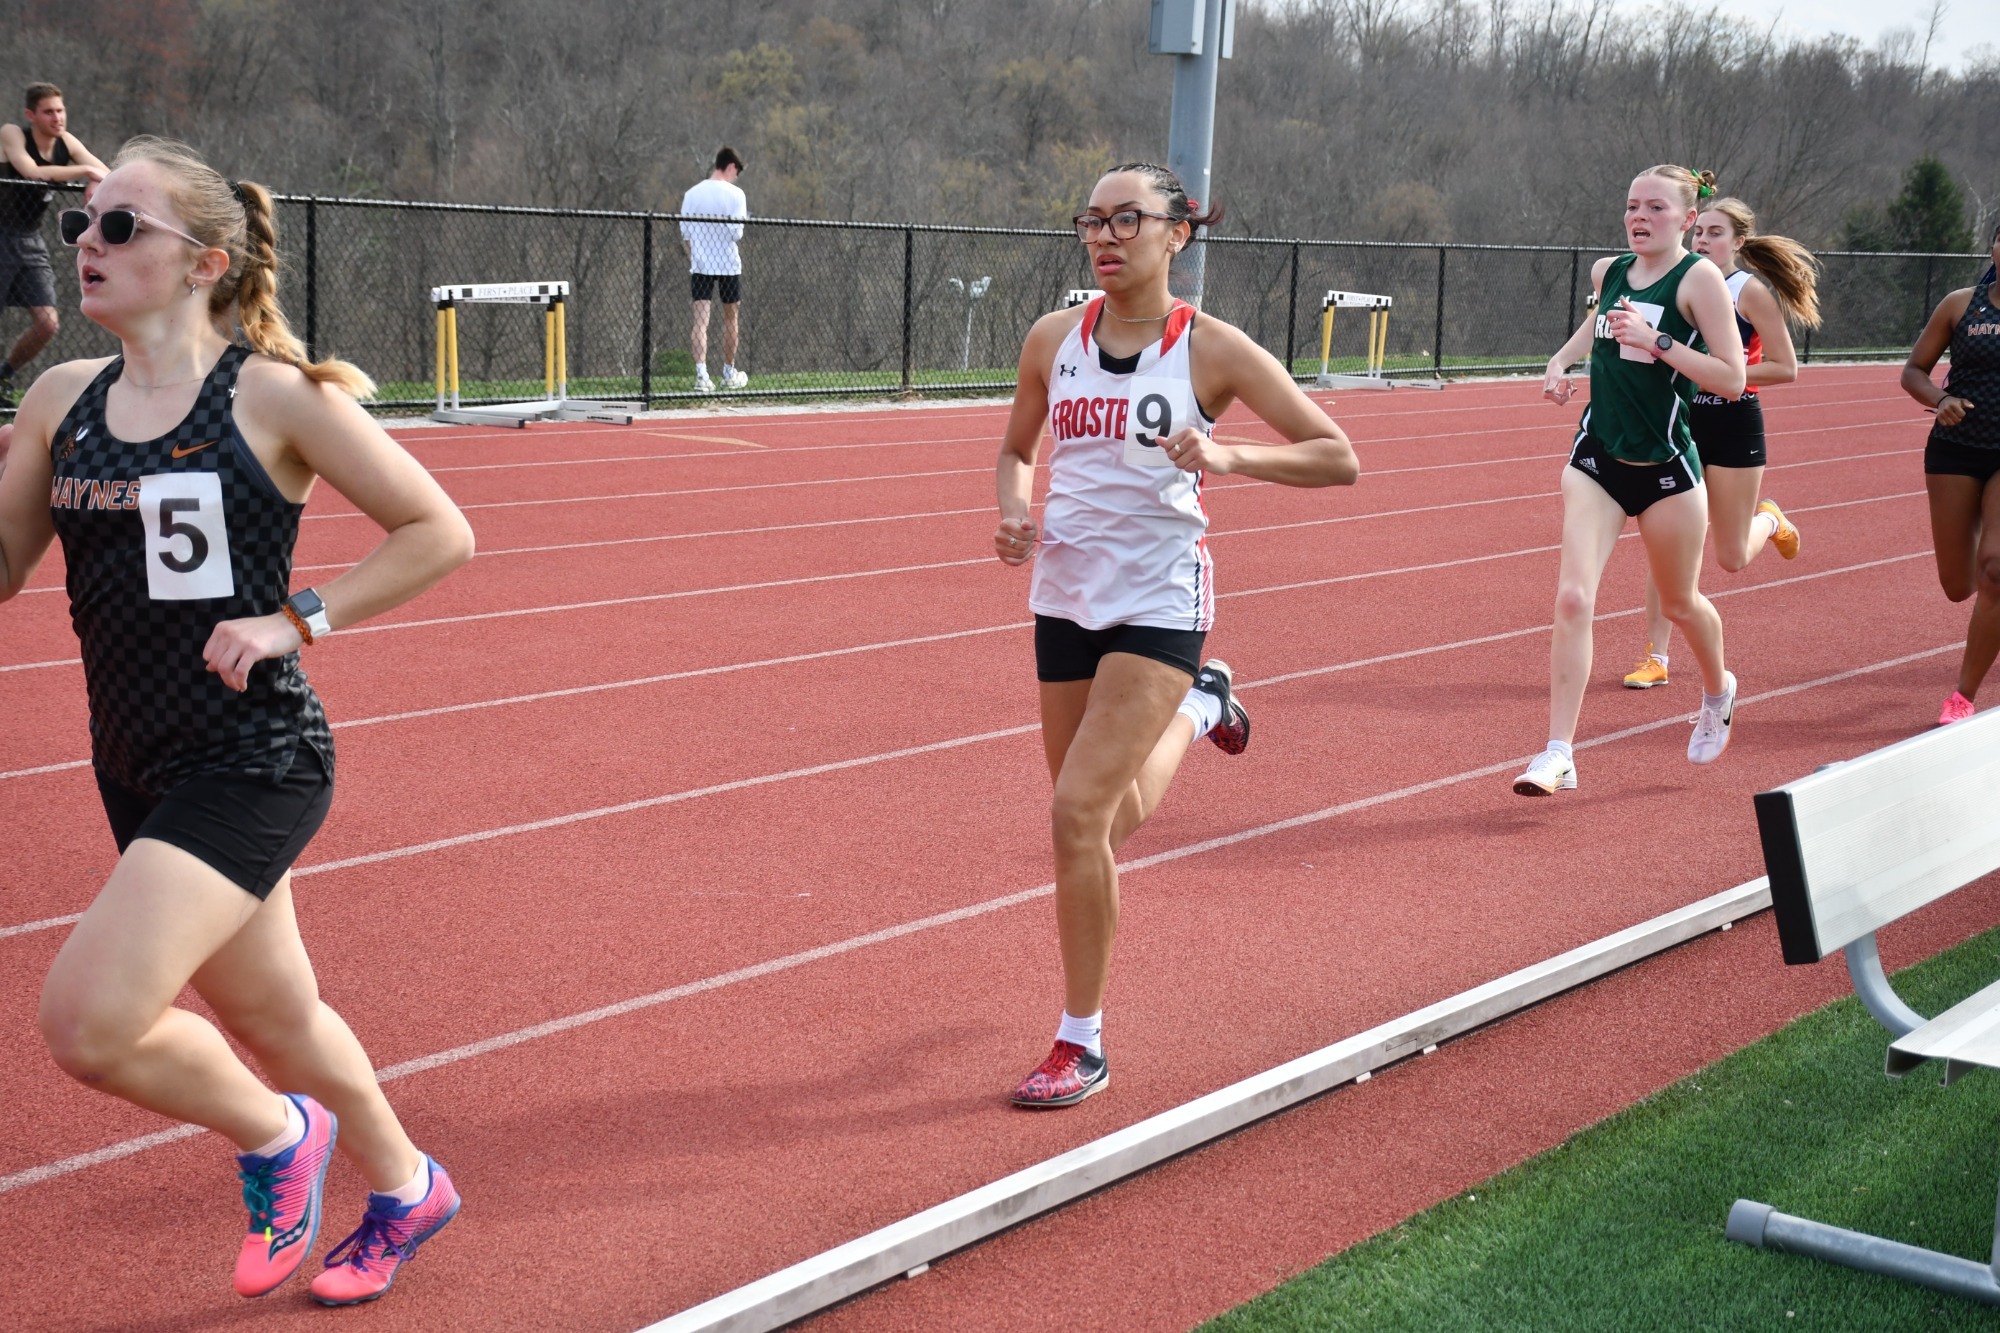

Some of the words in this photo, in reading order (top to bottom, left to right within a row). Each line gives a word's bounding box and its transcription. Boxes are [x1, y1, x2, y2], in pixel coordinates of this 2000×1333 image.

[478, 287, 502, 297] FIRST
[1135, 393, 1171, 447] 9
[1578, 459, 1600, 475] adidas
[50, 475, 141, 510] WAYNES
[1659, 476, 1677, 490] S
[158, 498, 209, 573] 5
